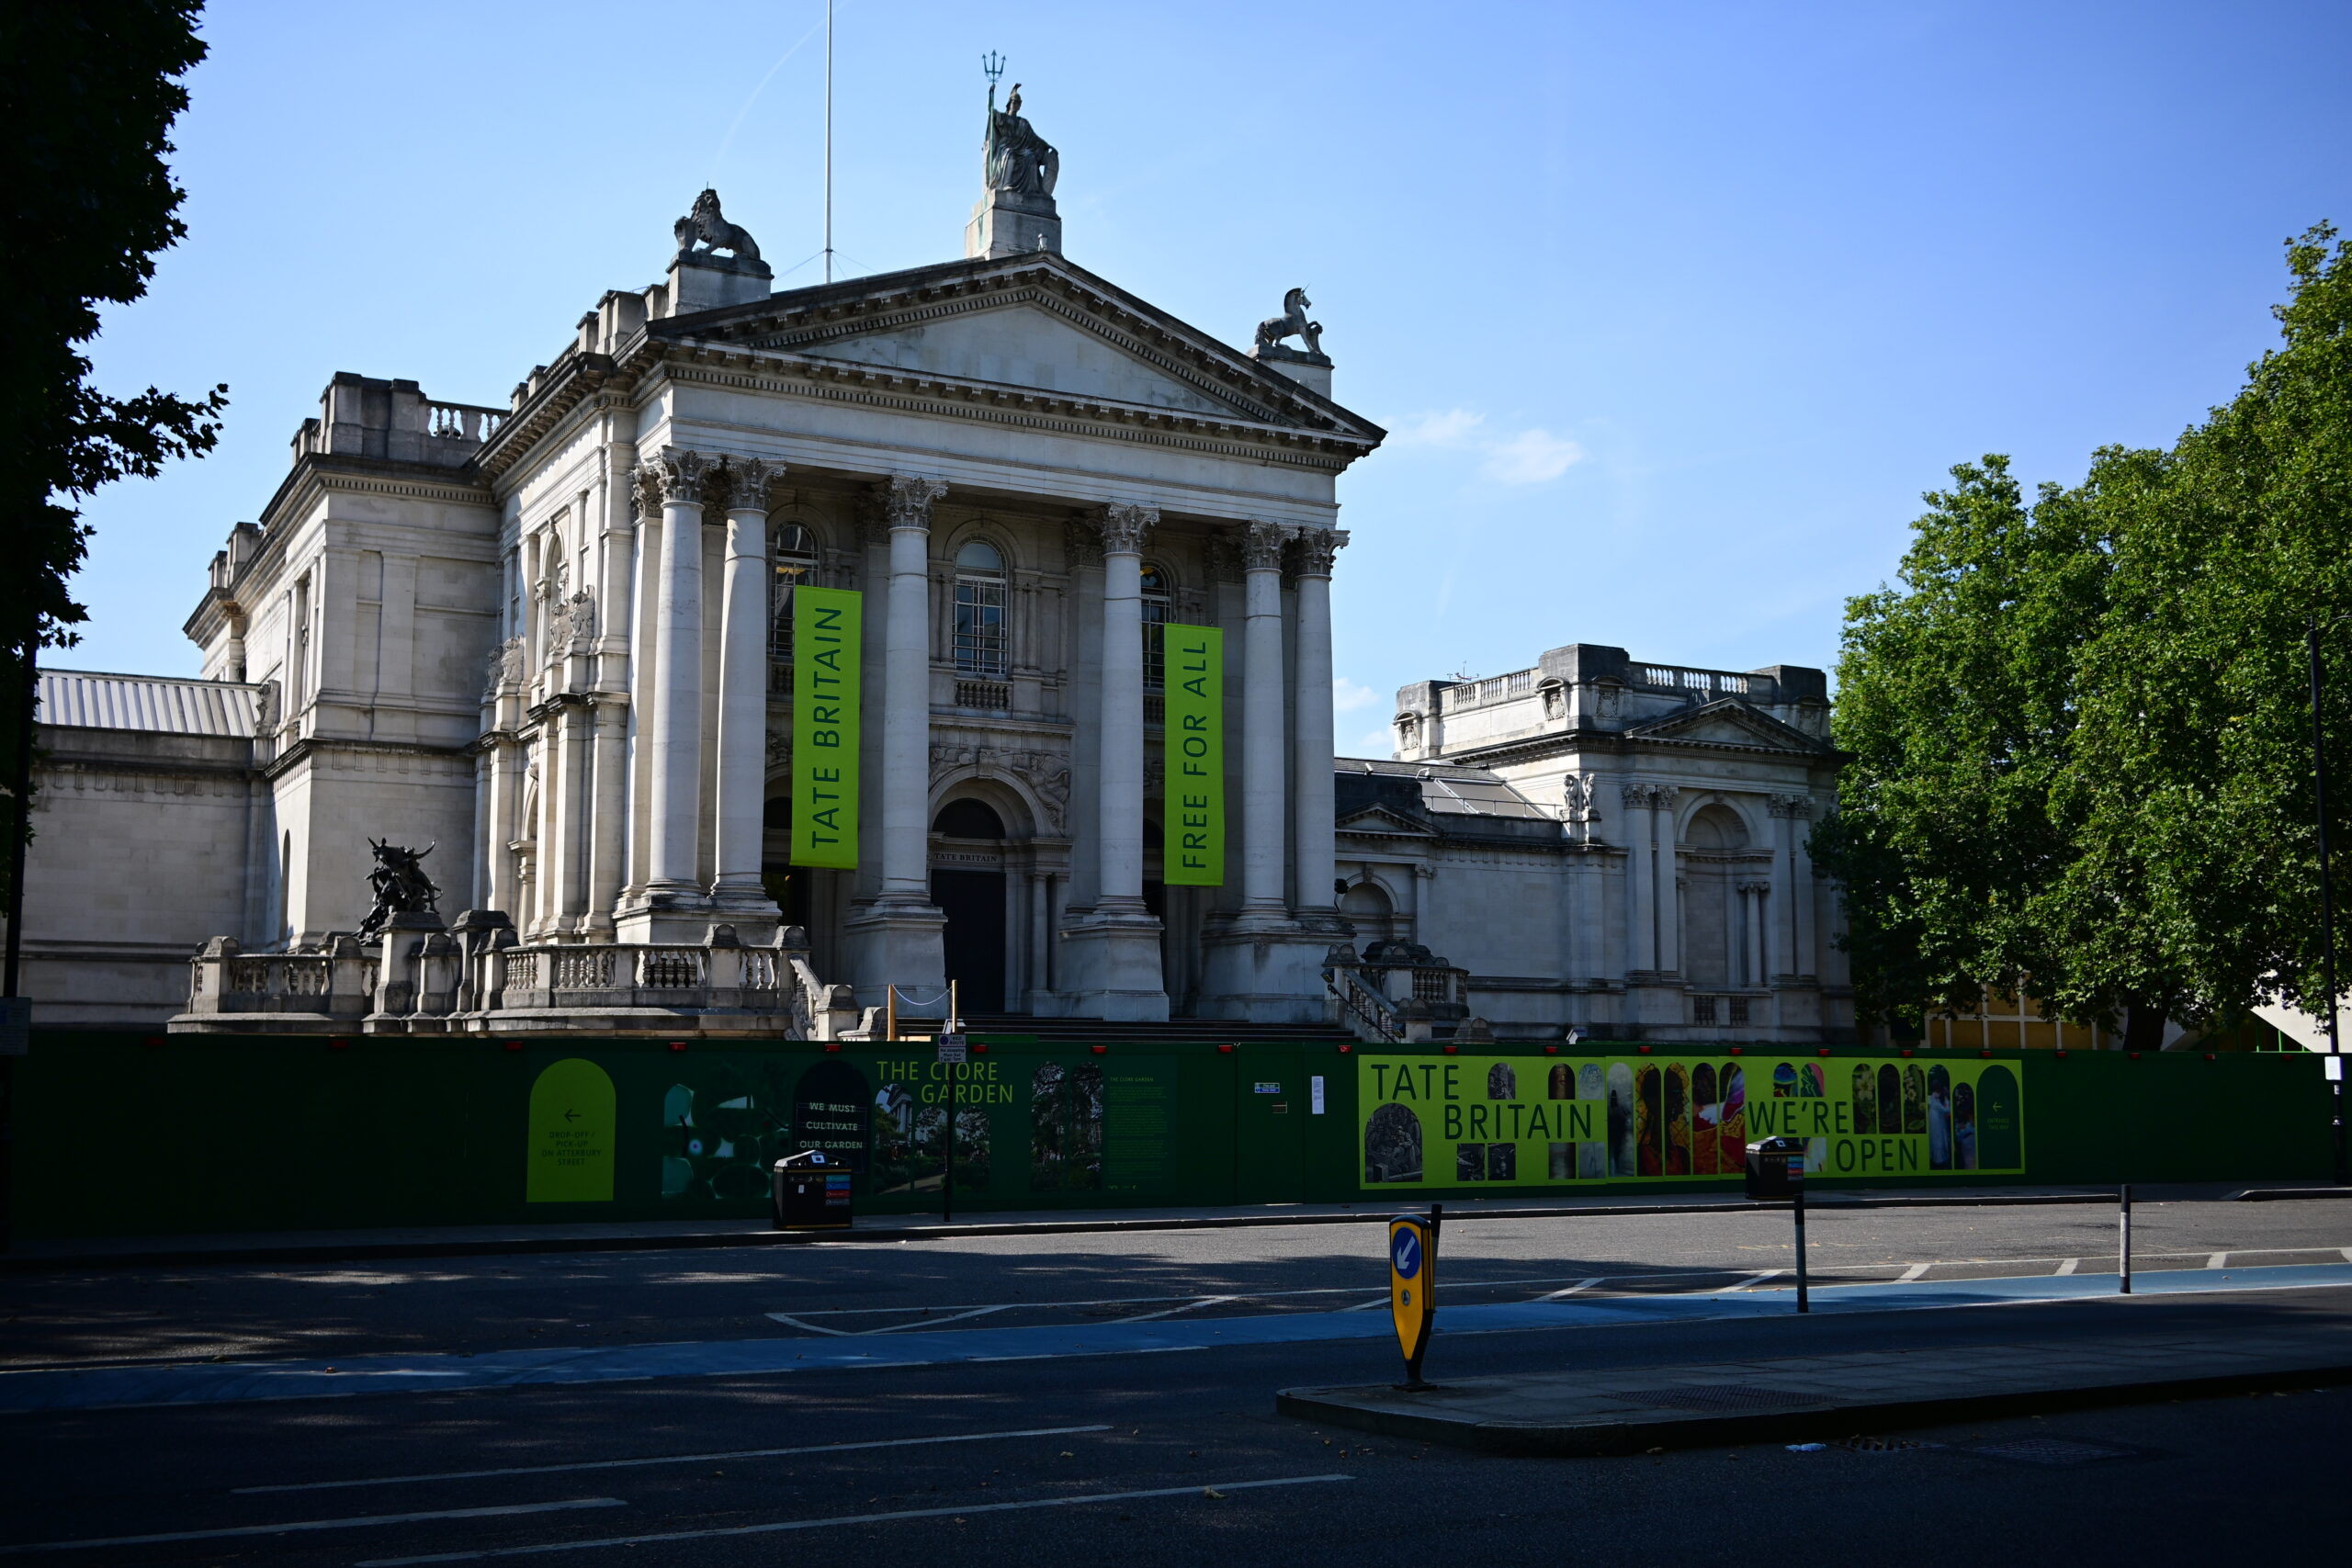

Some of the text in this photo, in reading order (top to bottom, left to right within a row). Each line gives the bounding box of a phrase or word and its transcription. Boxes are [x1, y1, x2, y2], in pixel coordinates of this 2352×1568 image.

[811, 607, 842, 849] TATE BRITAIN
[1182, 641, 1207, 869] FREE FOR ALL
[933, 852, 997, 863] TATE BRITAIN
[876, 1061, 919, 1080] THE
[1370, 1064, 1460, 1100] TATE
[921, 1084, 1014, 1103] GARDEN
[808, 1102, 856, 1112] WE MUST
[1444, 1104, 1591, 1140] BRITAIN
[1748, 1100, 1849, 1134] WE'RE
[806, 1122, 858, 1131] CULTIVATE
[548, 1131, 589, 1139] DROP-OFF
[556, 1139, 589, 1147] PICK-UP
[799, 1140, 864, 1149] OUR GARDEN
[541, 1148, 554, 1157] ON
[1836, 1139, 1917, 1171] OPEN
[558, 1157, 585, 1167] STREET
